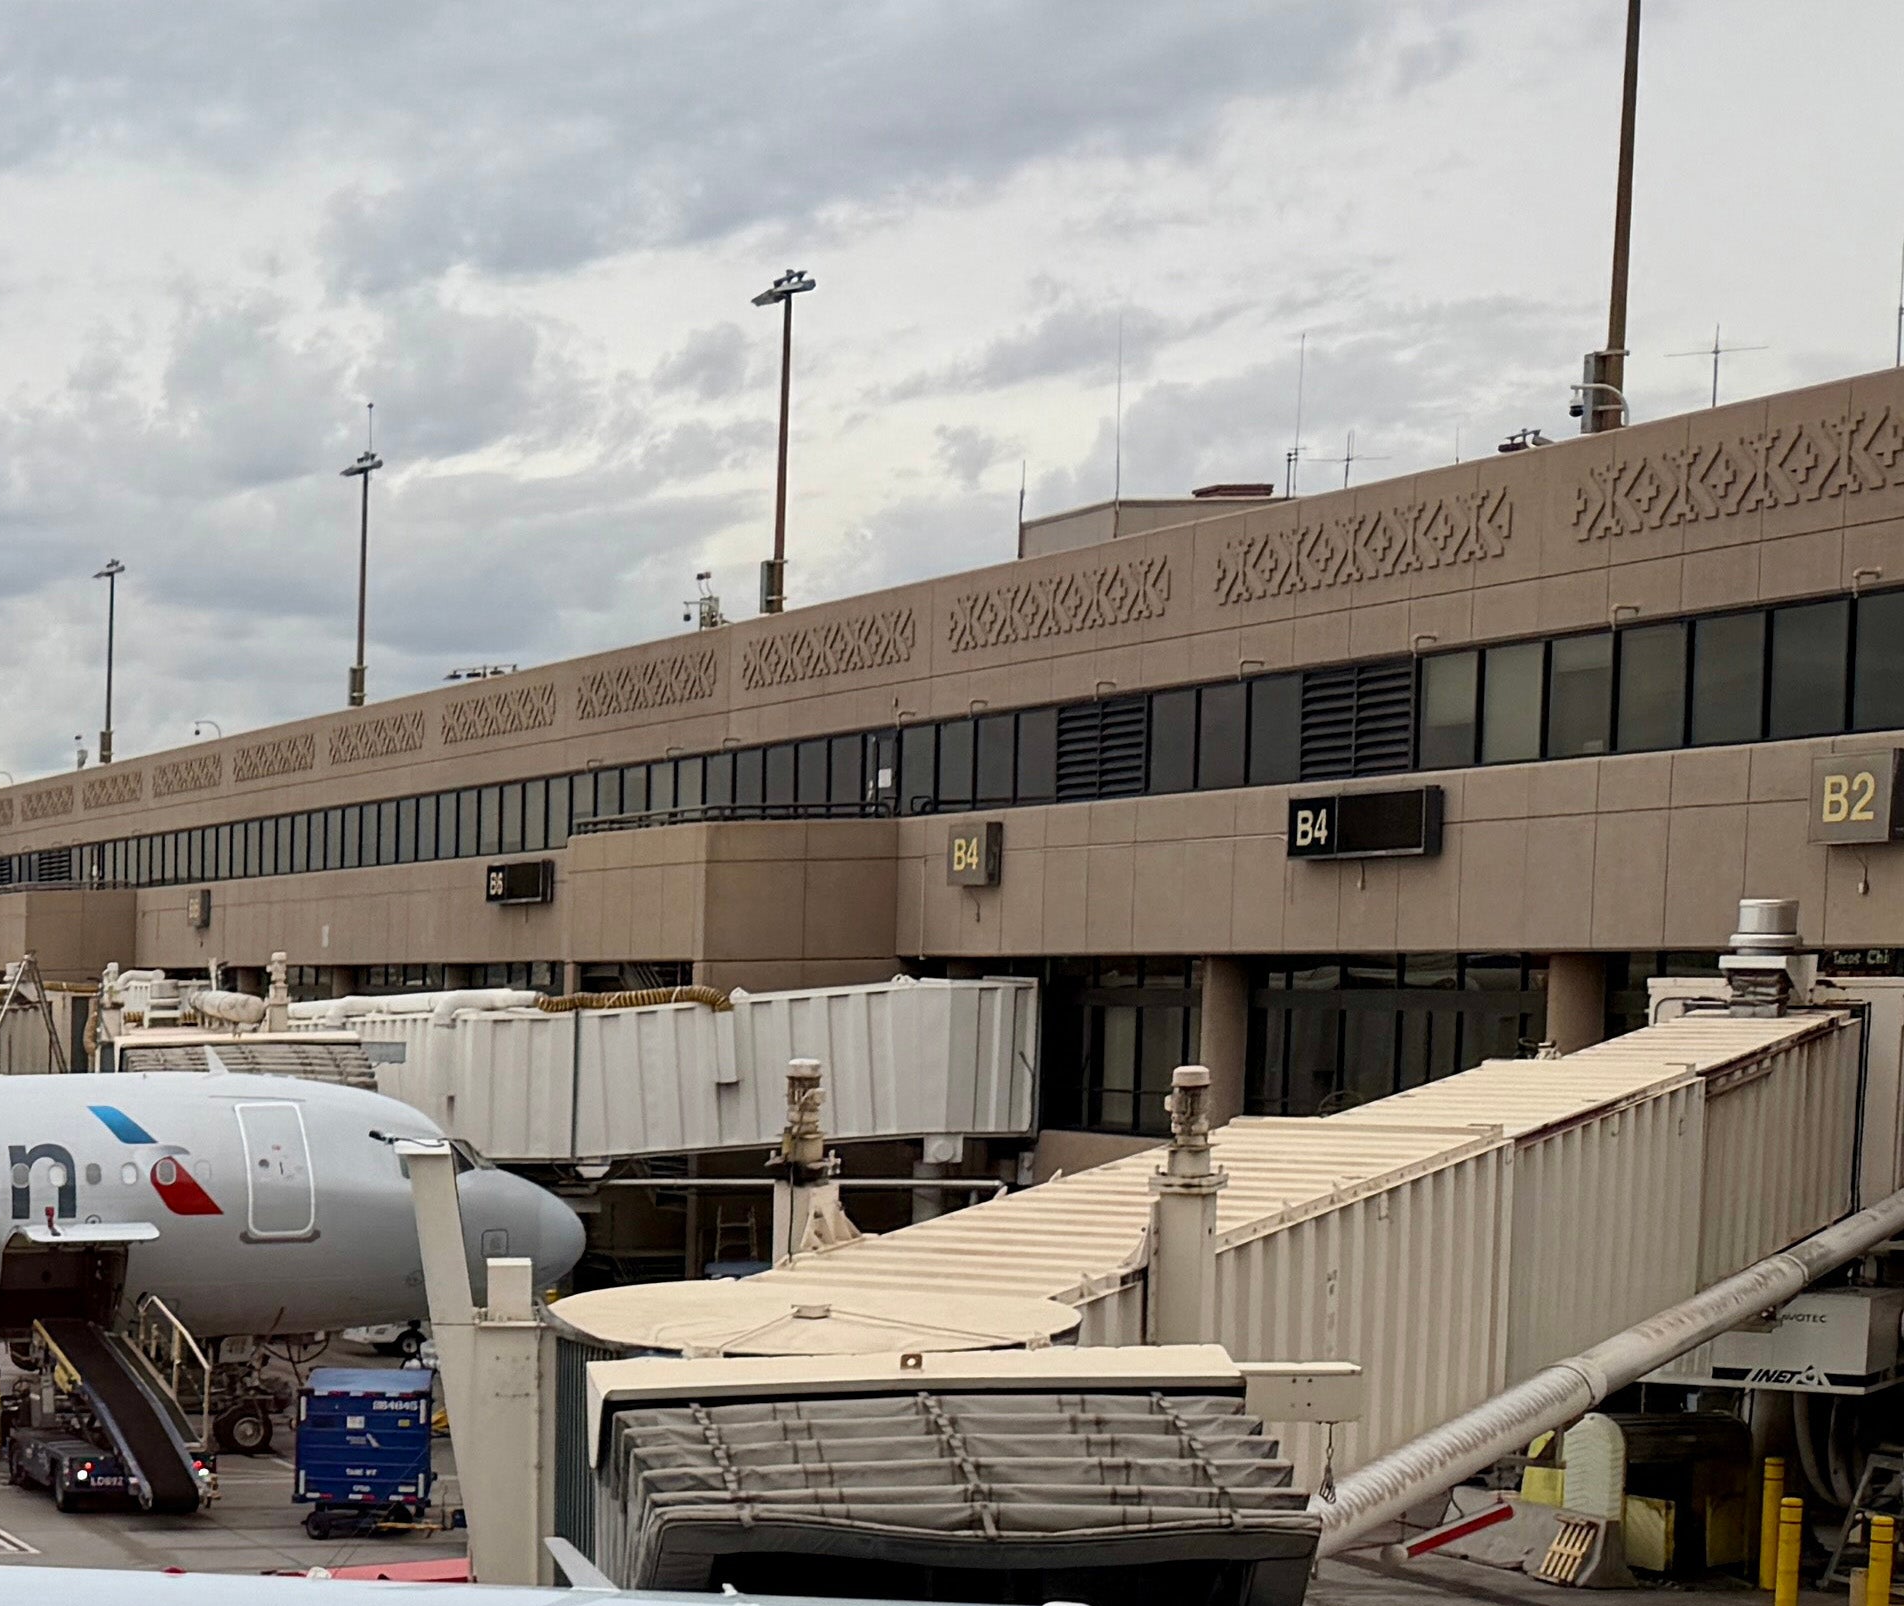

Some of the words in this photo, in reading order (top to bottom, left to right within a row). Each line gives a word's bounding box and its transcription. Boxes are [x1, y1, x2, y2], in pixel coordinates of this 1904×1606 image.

[1822, 771, 1876, 822] B2
[1296, 808, 1328, 846] B4
[953, 837, 979, 871] B4
[489, 872, 503, 896] B6
[1751, 1368, 1803, 1384] INET
